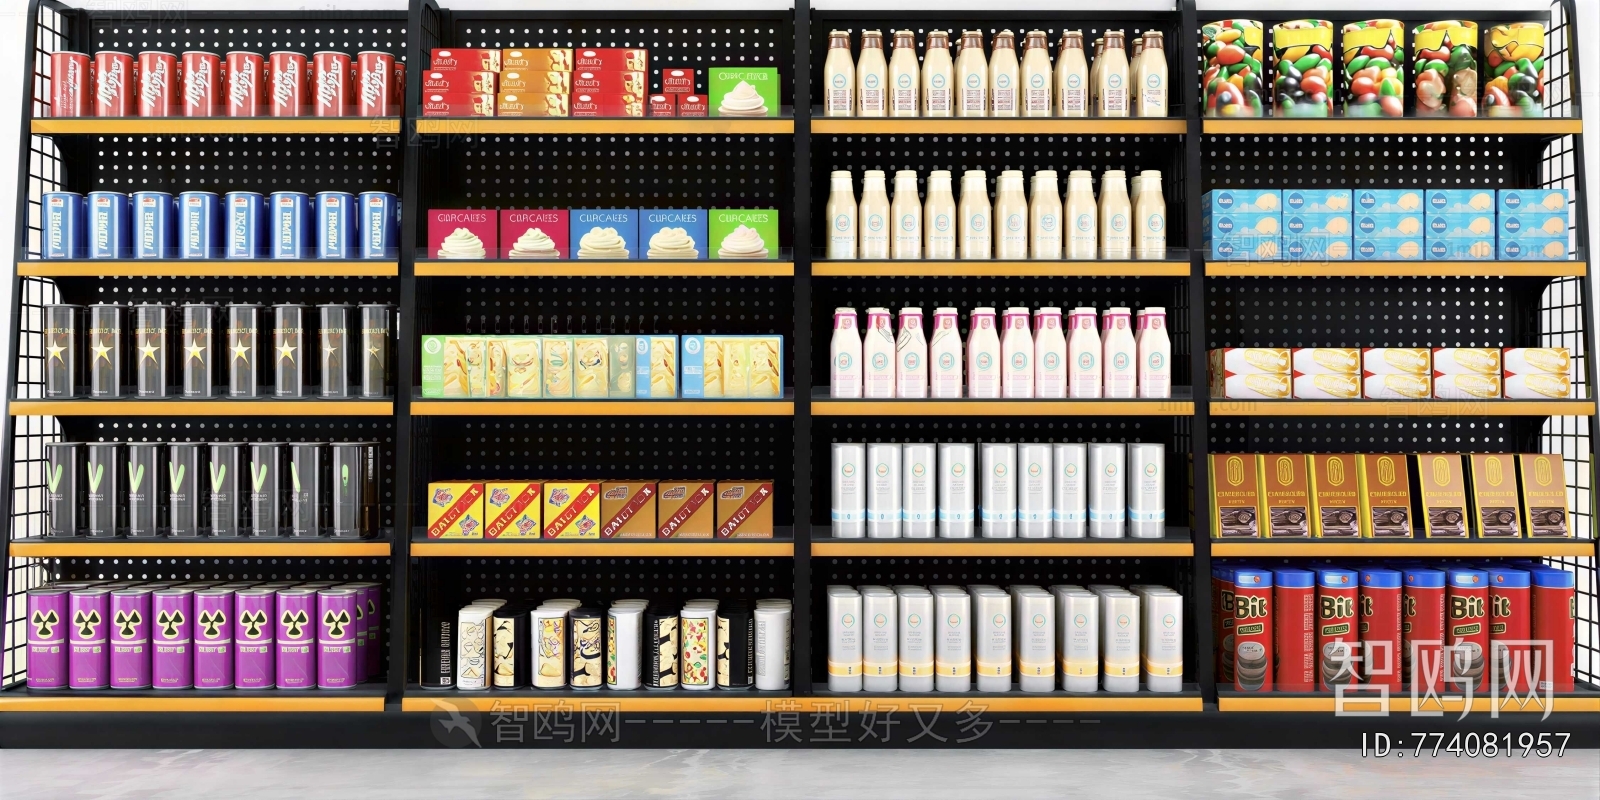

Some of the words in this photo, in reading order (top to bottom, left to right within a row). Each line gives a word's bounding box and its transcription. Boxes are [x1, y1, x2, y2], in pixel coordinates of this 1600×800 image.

[1235, 595, 1267, 620] Bit
[1320, 595, 1354, 620] Bit
[1451, 595, 1485, 620] Bit
